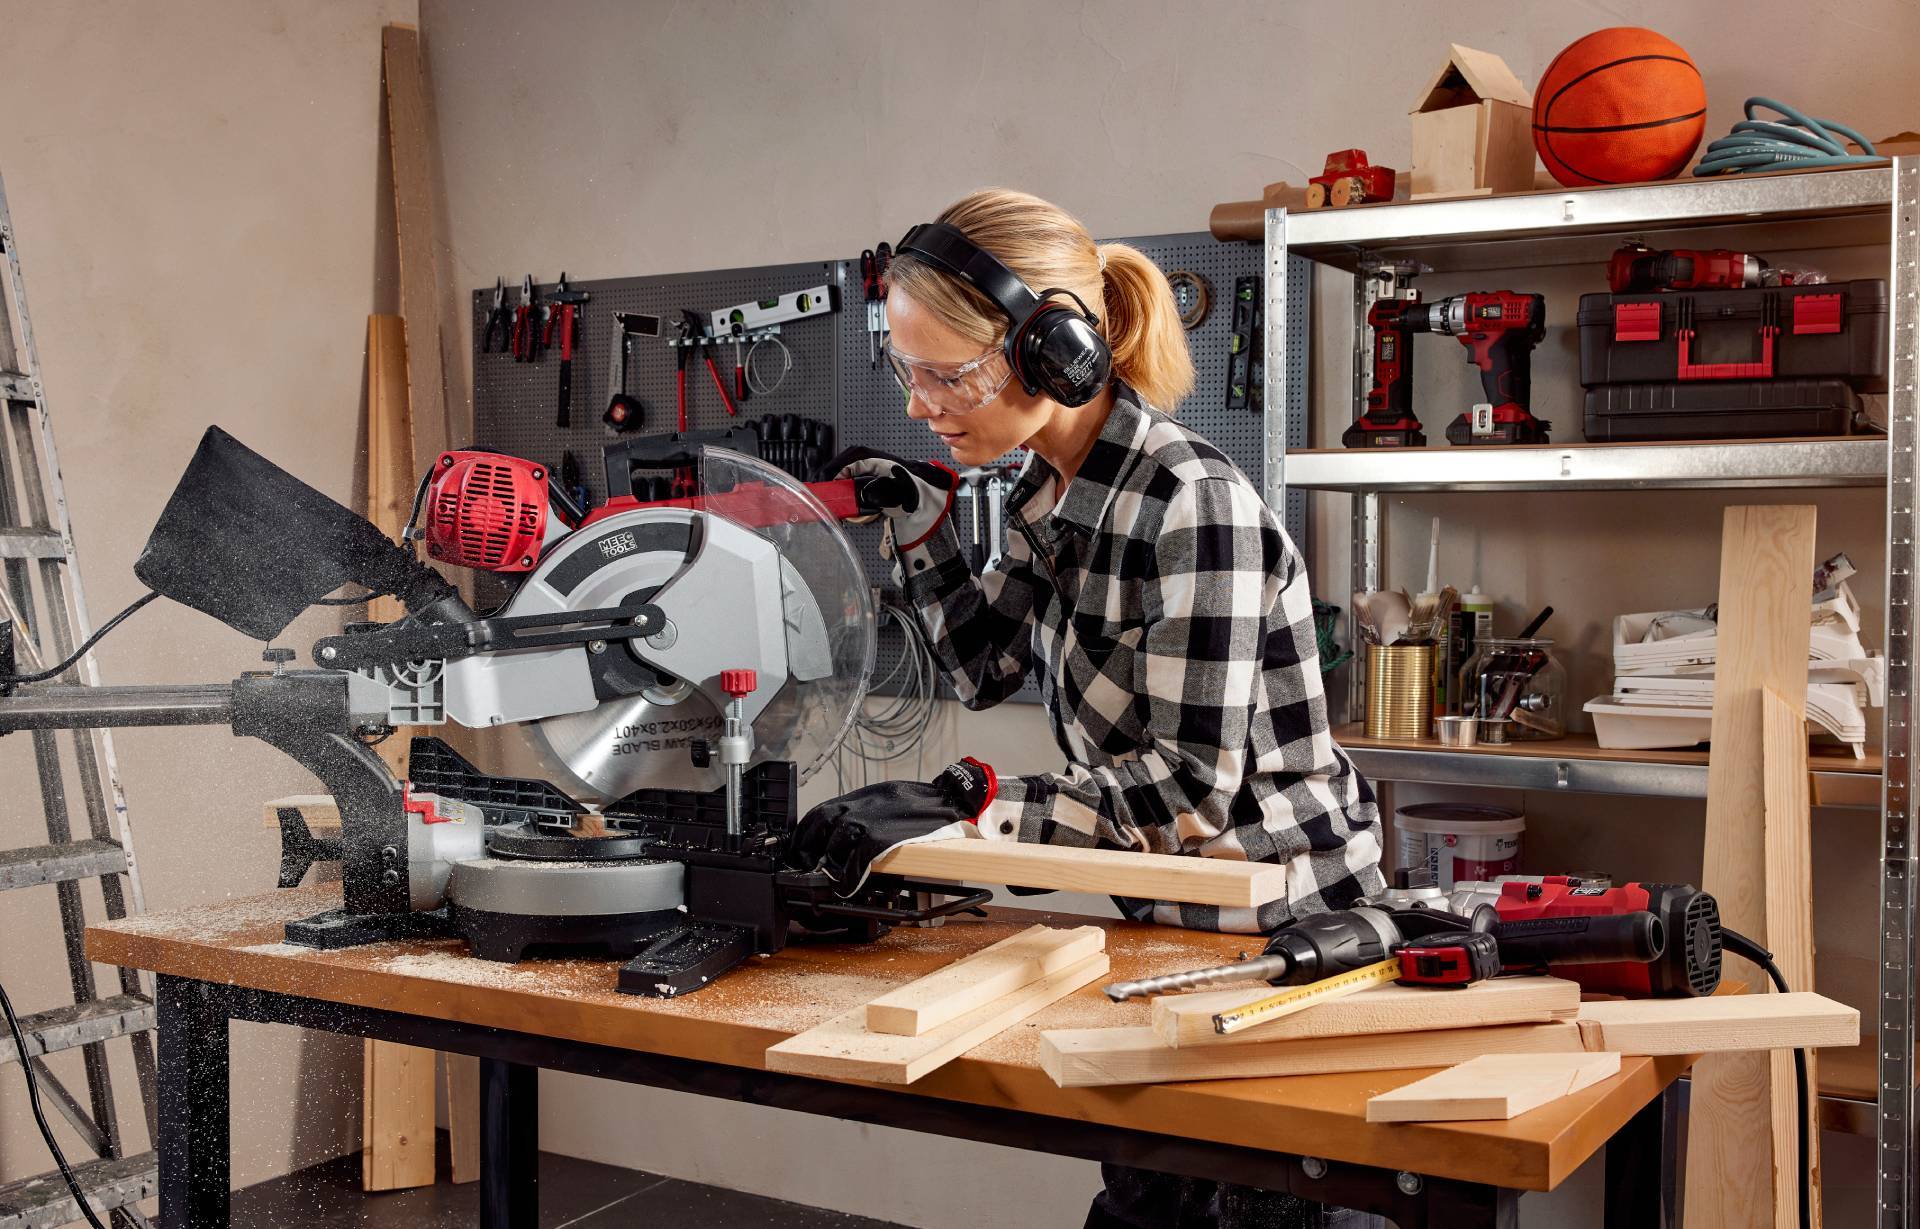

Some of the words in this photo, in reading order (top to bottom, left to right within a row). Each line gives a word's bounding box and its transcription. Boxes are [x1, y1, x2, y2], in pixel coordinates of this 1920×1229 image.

[598, 531, 635, 551] MEEC
[602, 540, 637, 559] TOOLS
[614, 715, 724, 740] 05x30x2.8x40T
[612, 740, 660, 756] BLADE
